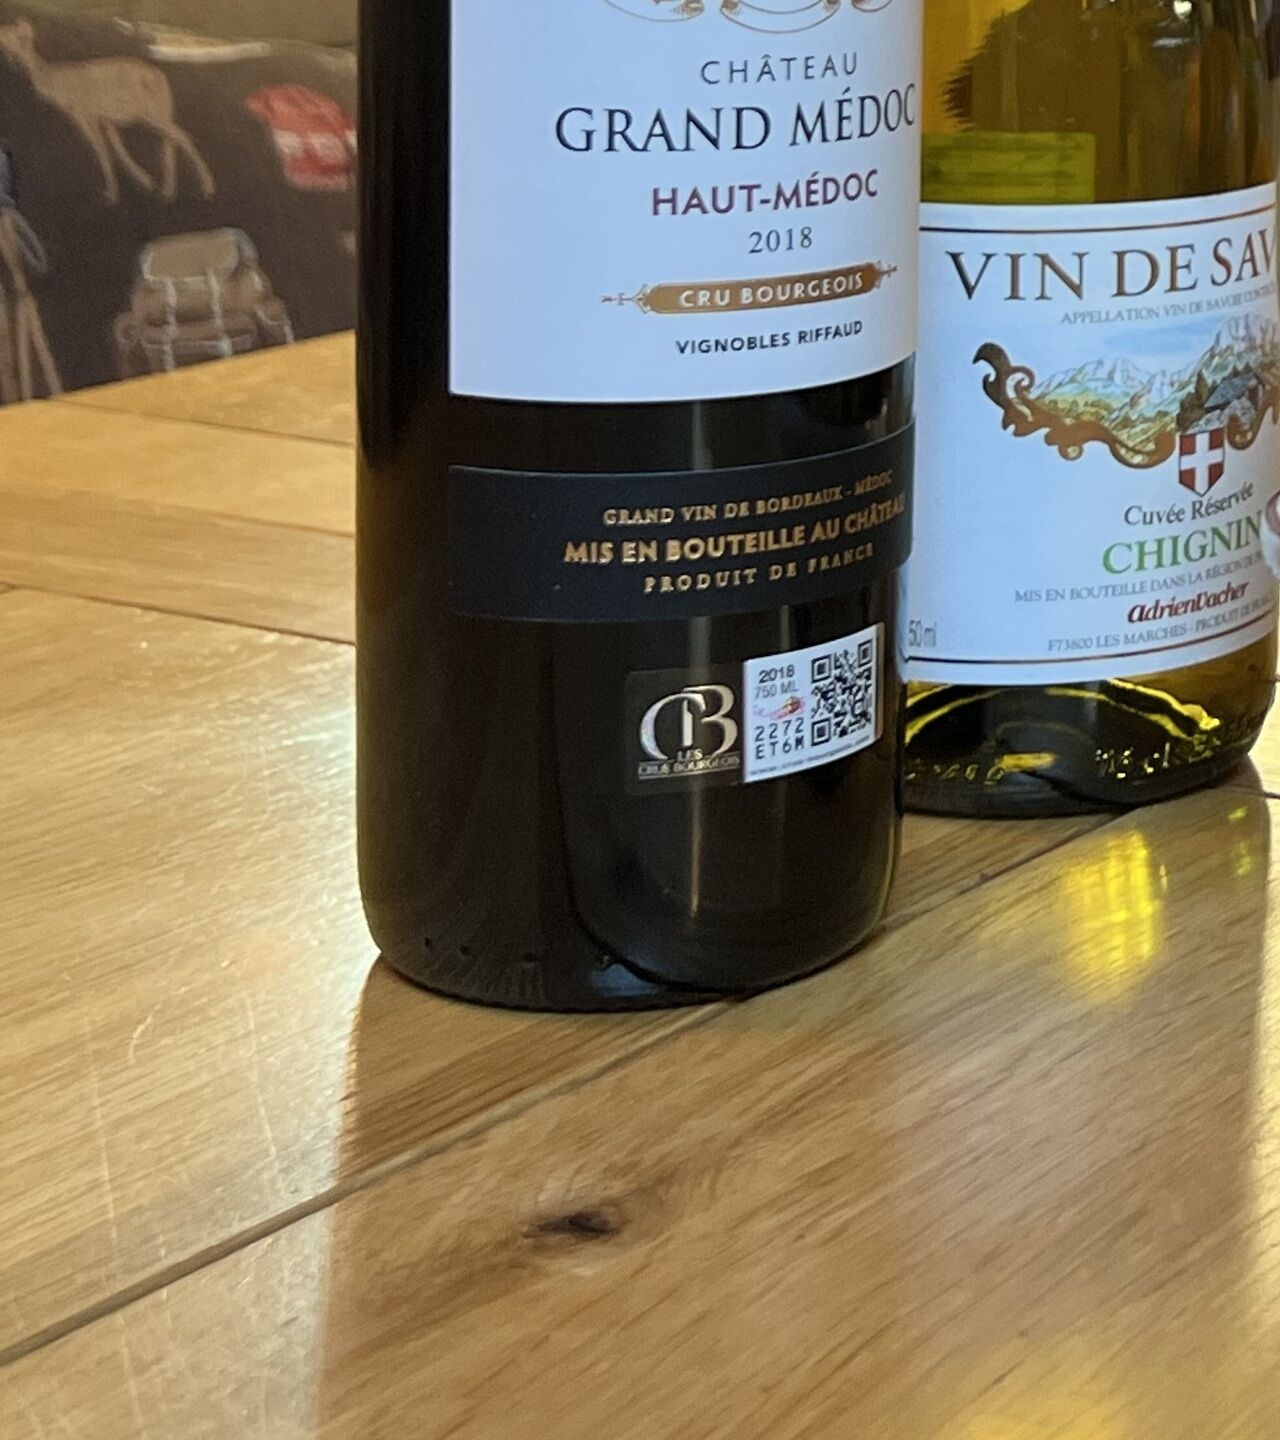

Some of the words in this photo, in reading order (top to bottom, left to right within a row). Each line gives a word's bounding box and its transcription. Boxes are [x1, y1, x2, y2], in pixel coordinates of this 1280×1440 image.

[700, 52, 857, 84] CHÂTEAU
[555, 106, 772, 152] GRAND
[789, 83, 916, 147] MÉDOC
[652, 168, 879, 216] HAUT-MÉDOC
[749, 225, 813, 253] 2018
[679, 288, 731, 308] CRU
[740, 271, 864, 305] BOURGEOIS
[945, 250, 1090, 301] VIN
[1111, 243, 1198, 298] DE
[1060, 306, 1160, 325] APPELLATION
[1163, 303, 1187, 317] VIN
[675, 330, 791, 355] VIGNOBLES
[798, 320, 863, 345] RIFFAUD
[603, 507, 675, 526] GRAND
[681, 504, 717, 522] VIN
[724, 501, 749, 519] DE
[756, 484, 843, 515] BORDEAUX
[1124, 502, 1186, 526] Cuvée
[1191, 481, 1254, 521] Réservée
[564, 541, 614, 564] MIS
[622, 540, 658, 564] EN
[665, 523, 806, 562] BOUTEILLE
[810, 517, 840, 544] AU
[845, 491, 906, 534] CHÂTEAU
[644, 567, 757, 594] PRODUIT
[769, 562, 797, 581] DE
[808, 541, 874, 574] FRANCE
[1015, 588, 1042, 603] MIS
[1046, 587, 1065, 602] EN
[1070, 579, 1149, 602] BOUTEILLE
[1096, 633, 1121, 649] LES
[1124, 622, 1187, 645] MARCHES
[755, 684, 778, 700] 750
[781, 681, 799, 696] ML
[758, 664, 796, 684] 2018
[755, 717, 804, 742] 2272
